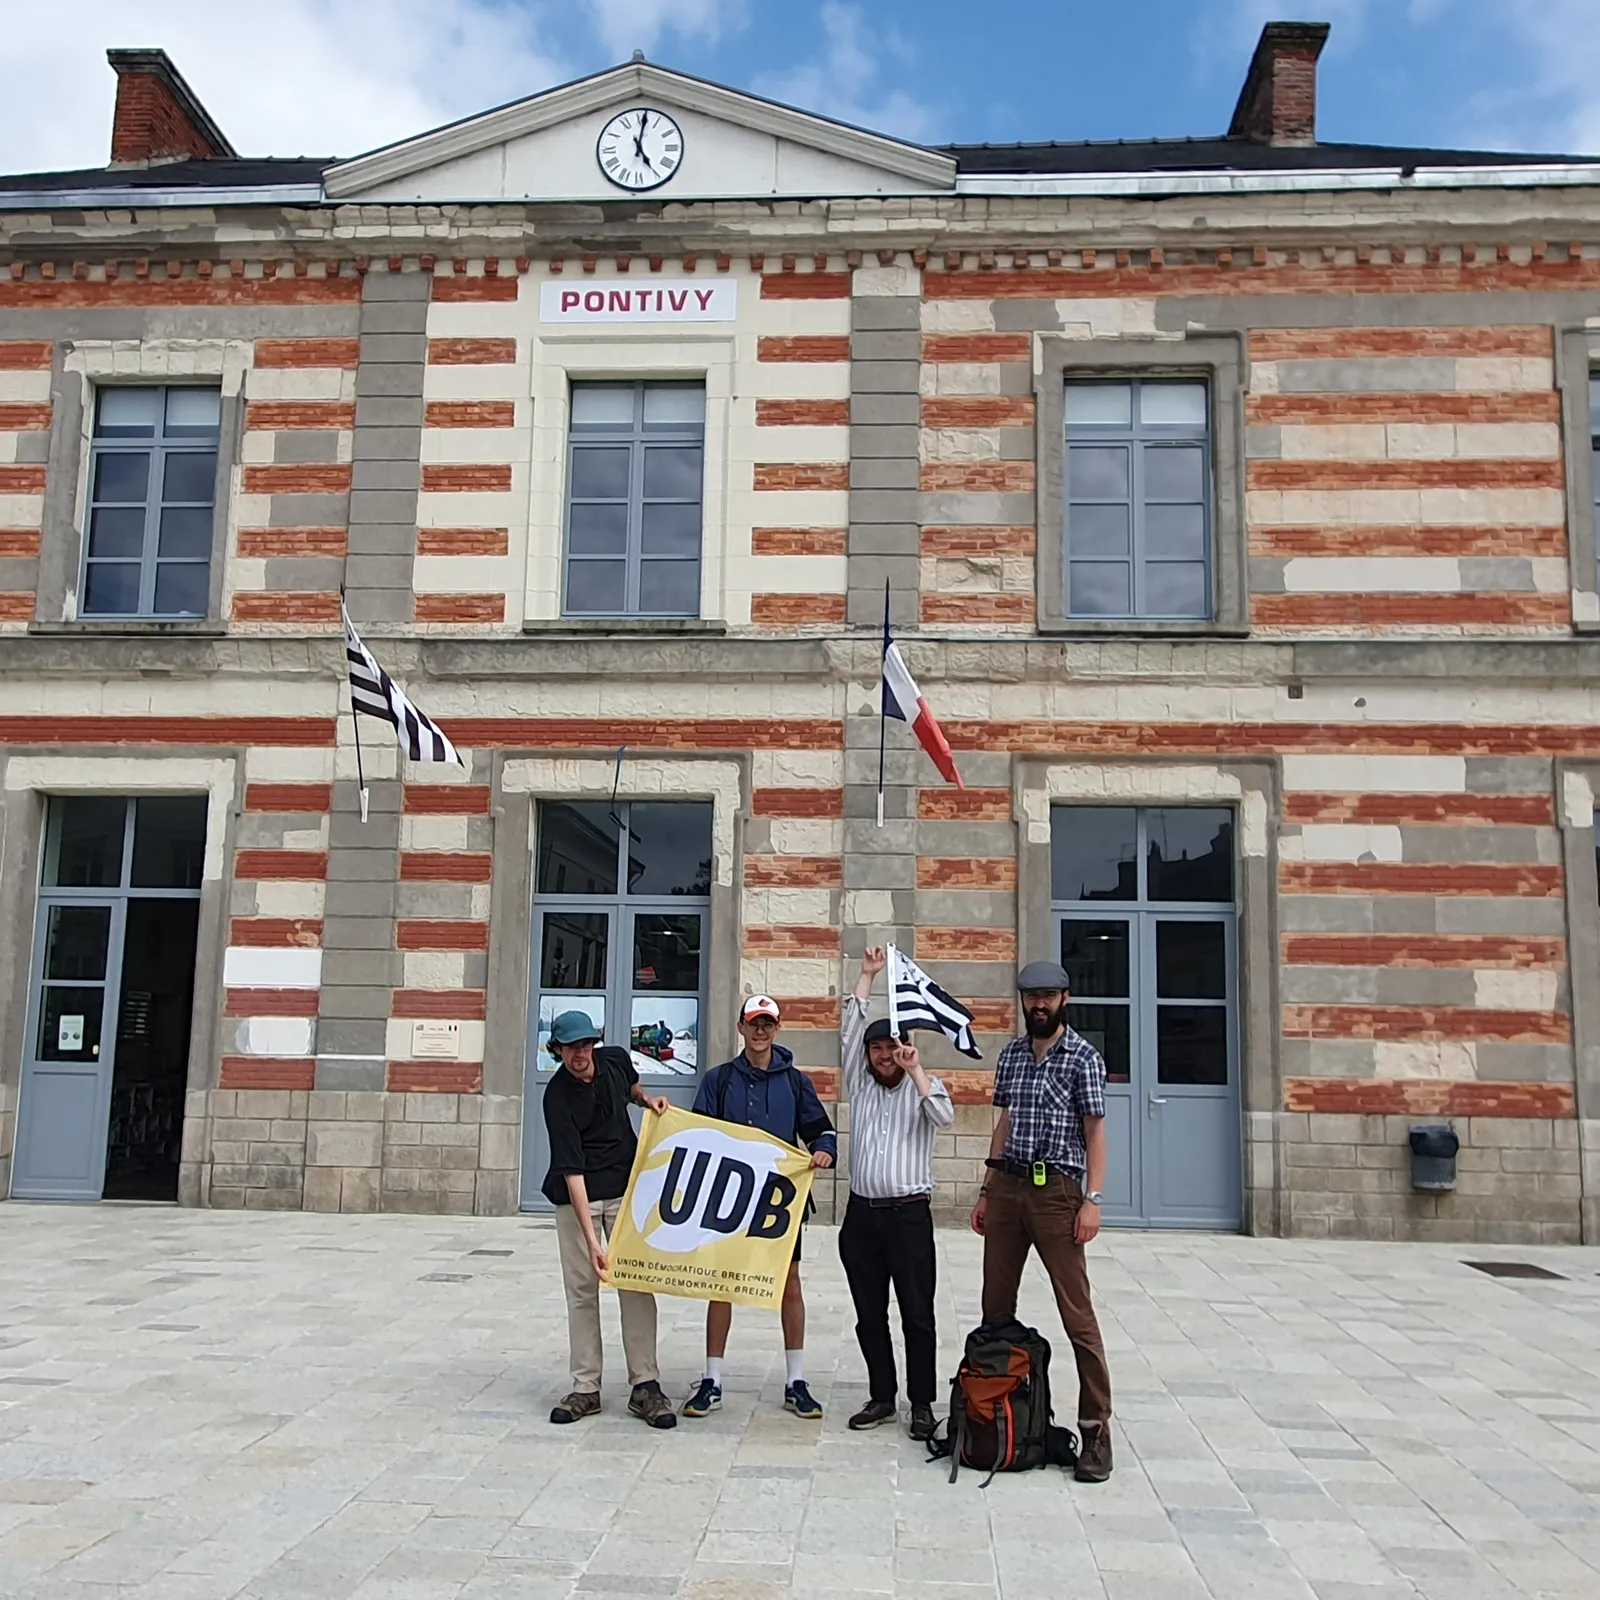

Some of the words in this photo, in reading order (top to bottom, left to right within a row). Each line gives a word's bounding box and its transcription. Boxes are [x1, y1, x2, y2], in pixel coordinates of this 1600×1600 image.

[561, 289, 715, 312] PONTIVY
[658, 1146, 797, 1239] UDB
[614, 1271, 663, 1284] UNVANIEZH
[664, 1277, 730, 1292] DEMOKRATEL
[734, 1285, 774, 1298] BREIZH
[616, 1257, 645, 1269] UNION
[721, 1270, 776, 1285] BRETONNE
